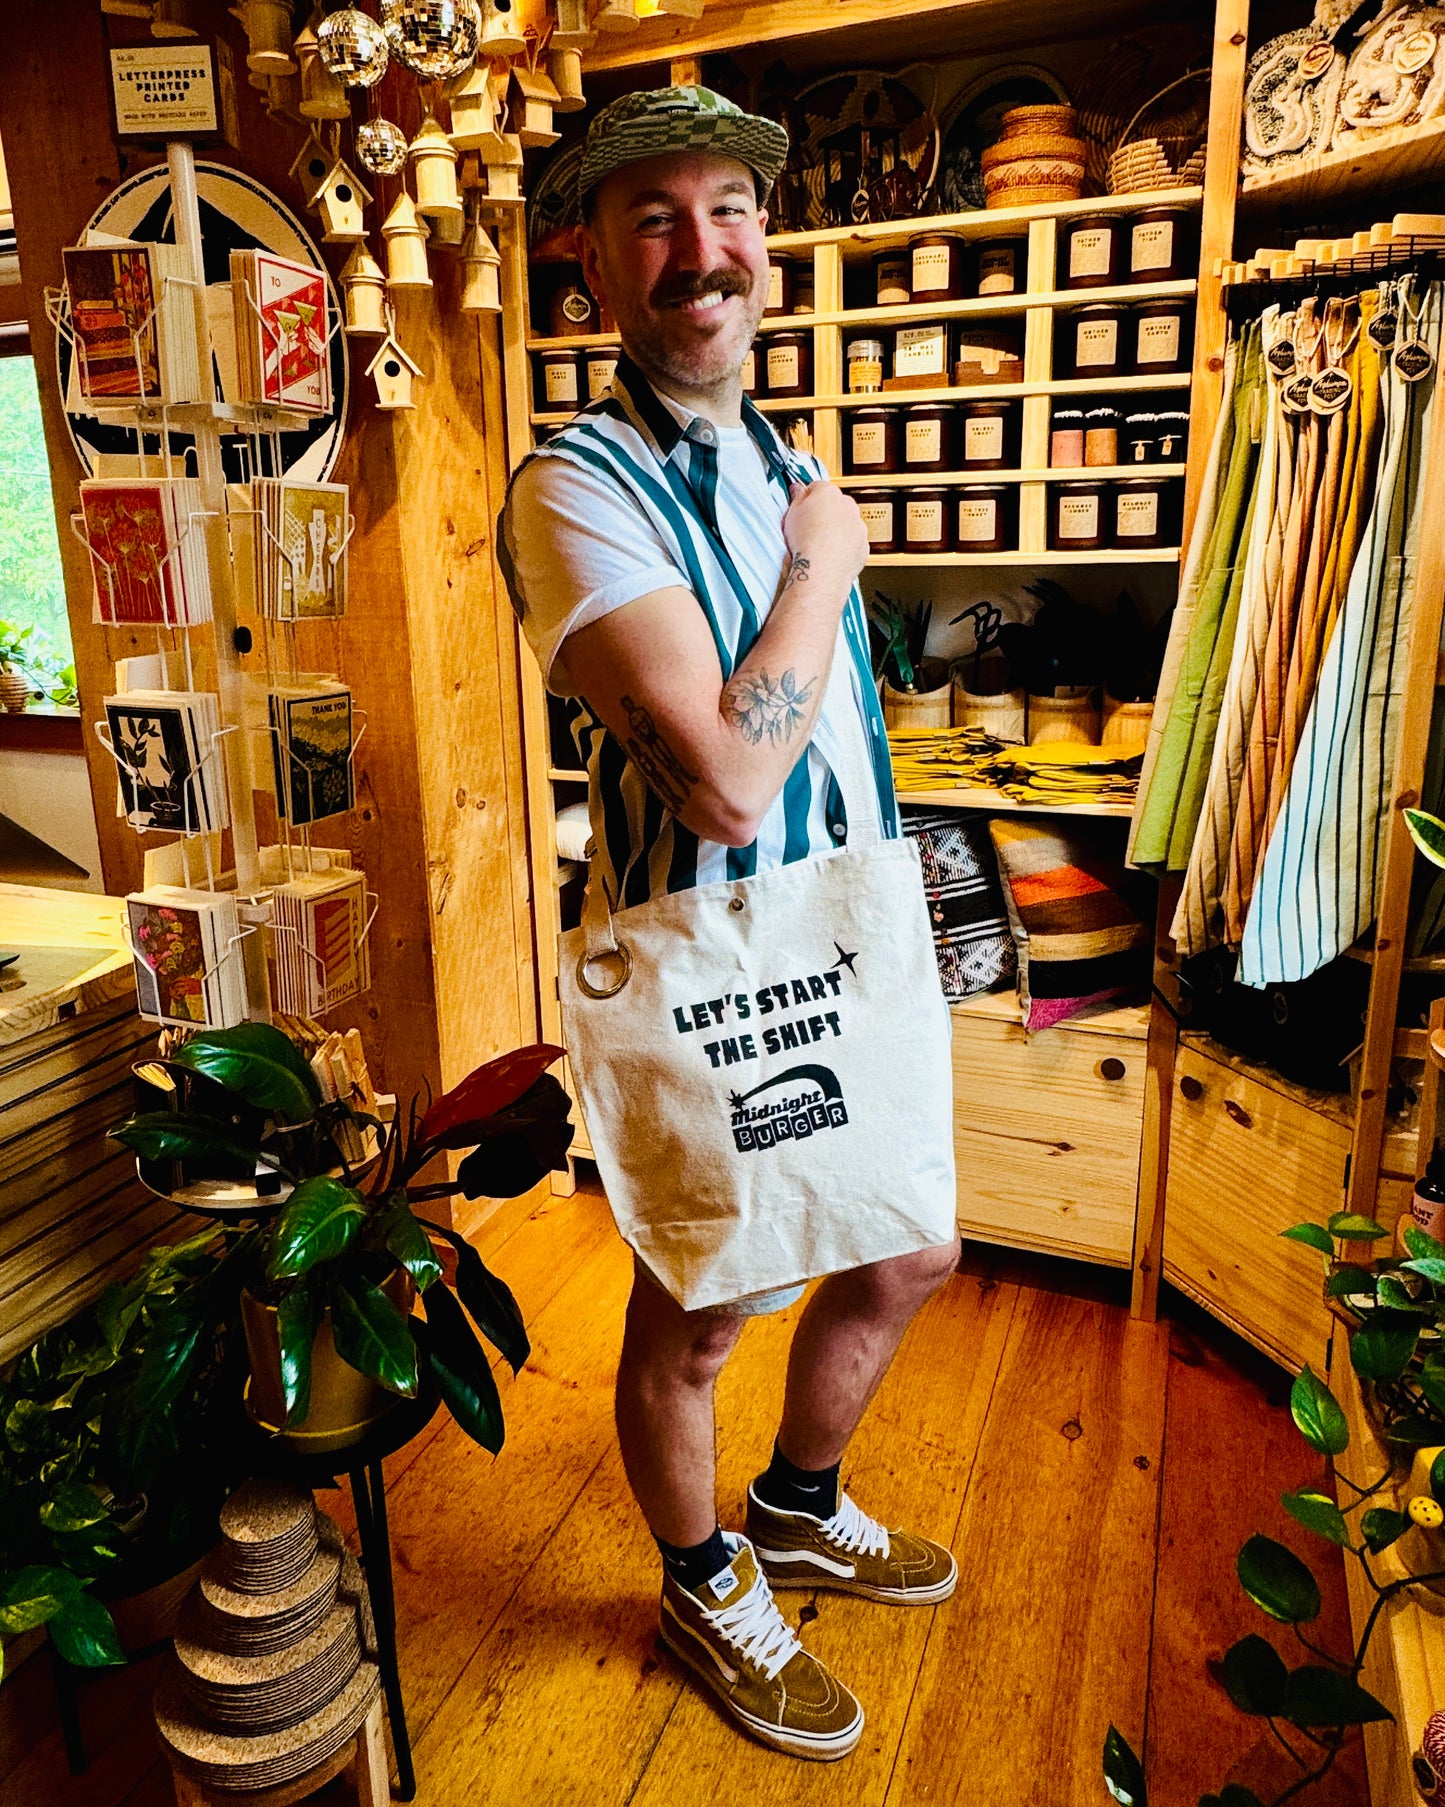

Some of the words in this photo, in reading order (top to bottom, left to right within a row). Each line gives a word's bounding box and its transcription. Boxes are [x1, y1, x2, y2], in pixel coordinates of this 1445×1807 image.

[118, 69, 206, 81] LETTERPRESS
[136, 81, 190, 91] PRINTED
[143, 92, 185, 103] CARDS
[270, 276, 281, 287] TO
[312, 703, 332, 715] THANK
[333, 701, 346, 711] YOU
[318, 976, 360, 1007] BRTHDAY
[672, 993, 751, 1034] LET'S
[755, 970, 842, 1015] START
[703, 1034, 758, 1069] THE
[762, 1011, 842, 1055] SHIFT
[730, 1090, 823, 1127] Midnight
[734, 1103, 847, 1150] BURGER
